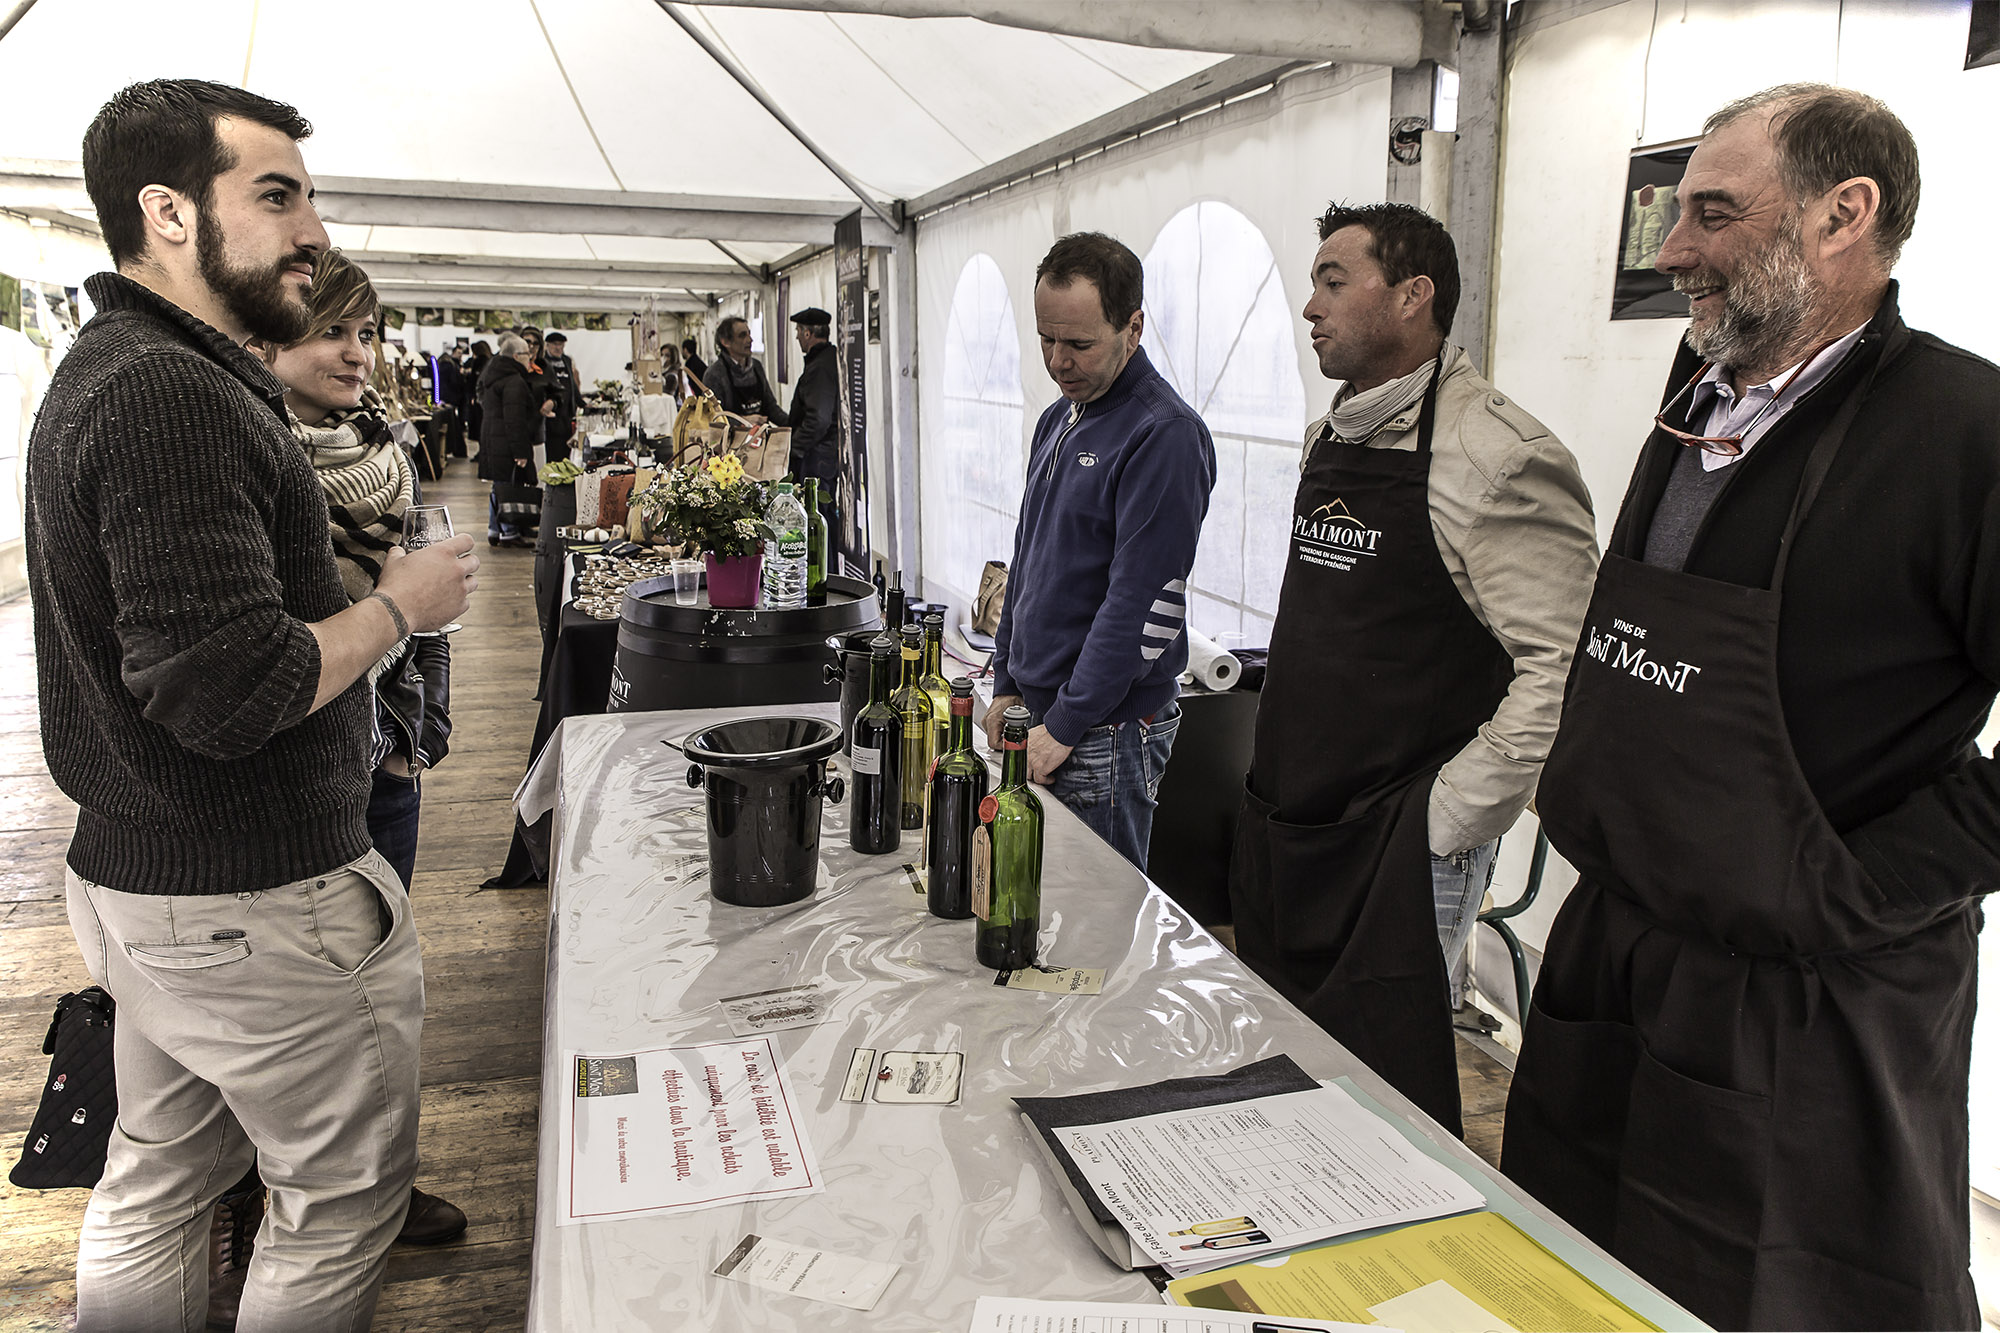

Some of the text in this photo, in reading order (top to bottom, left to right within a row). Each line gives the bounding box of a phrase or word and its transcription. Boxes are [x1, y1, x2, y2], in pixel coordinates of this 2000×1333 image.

[1294, 515, 1382, 550] PLAIMONT
[1299, 546, 1323, 557] VIGNERONS
[1330, 553, 1357, 564] GASCOGNE
[1304, 555, 1324, 565] TERROIRS
[1613, 618, 1648, 640] VINS DE
[1611, 640, 1702, 694] MONT
[662, 1069, 694, 1182] effectués dans la boutique.
[702, 1064, 743, 1175] uniquement pour les achats
[741, 1051, 792, 1178] La carte de fidélité est valable
[1101, 1182, 1120, 1204] Mont
[1118, 1203, 1137, 1222] Saint
[1134, 1222, 1146, 1231] du
[1143, 1231, 1162, 1250] Faîte
[1159, 1250, 1172, 1258] Le
